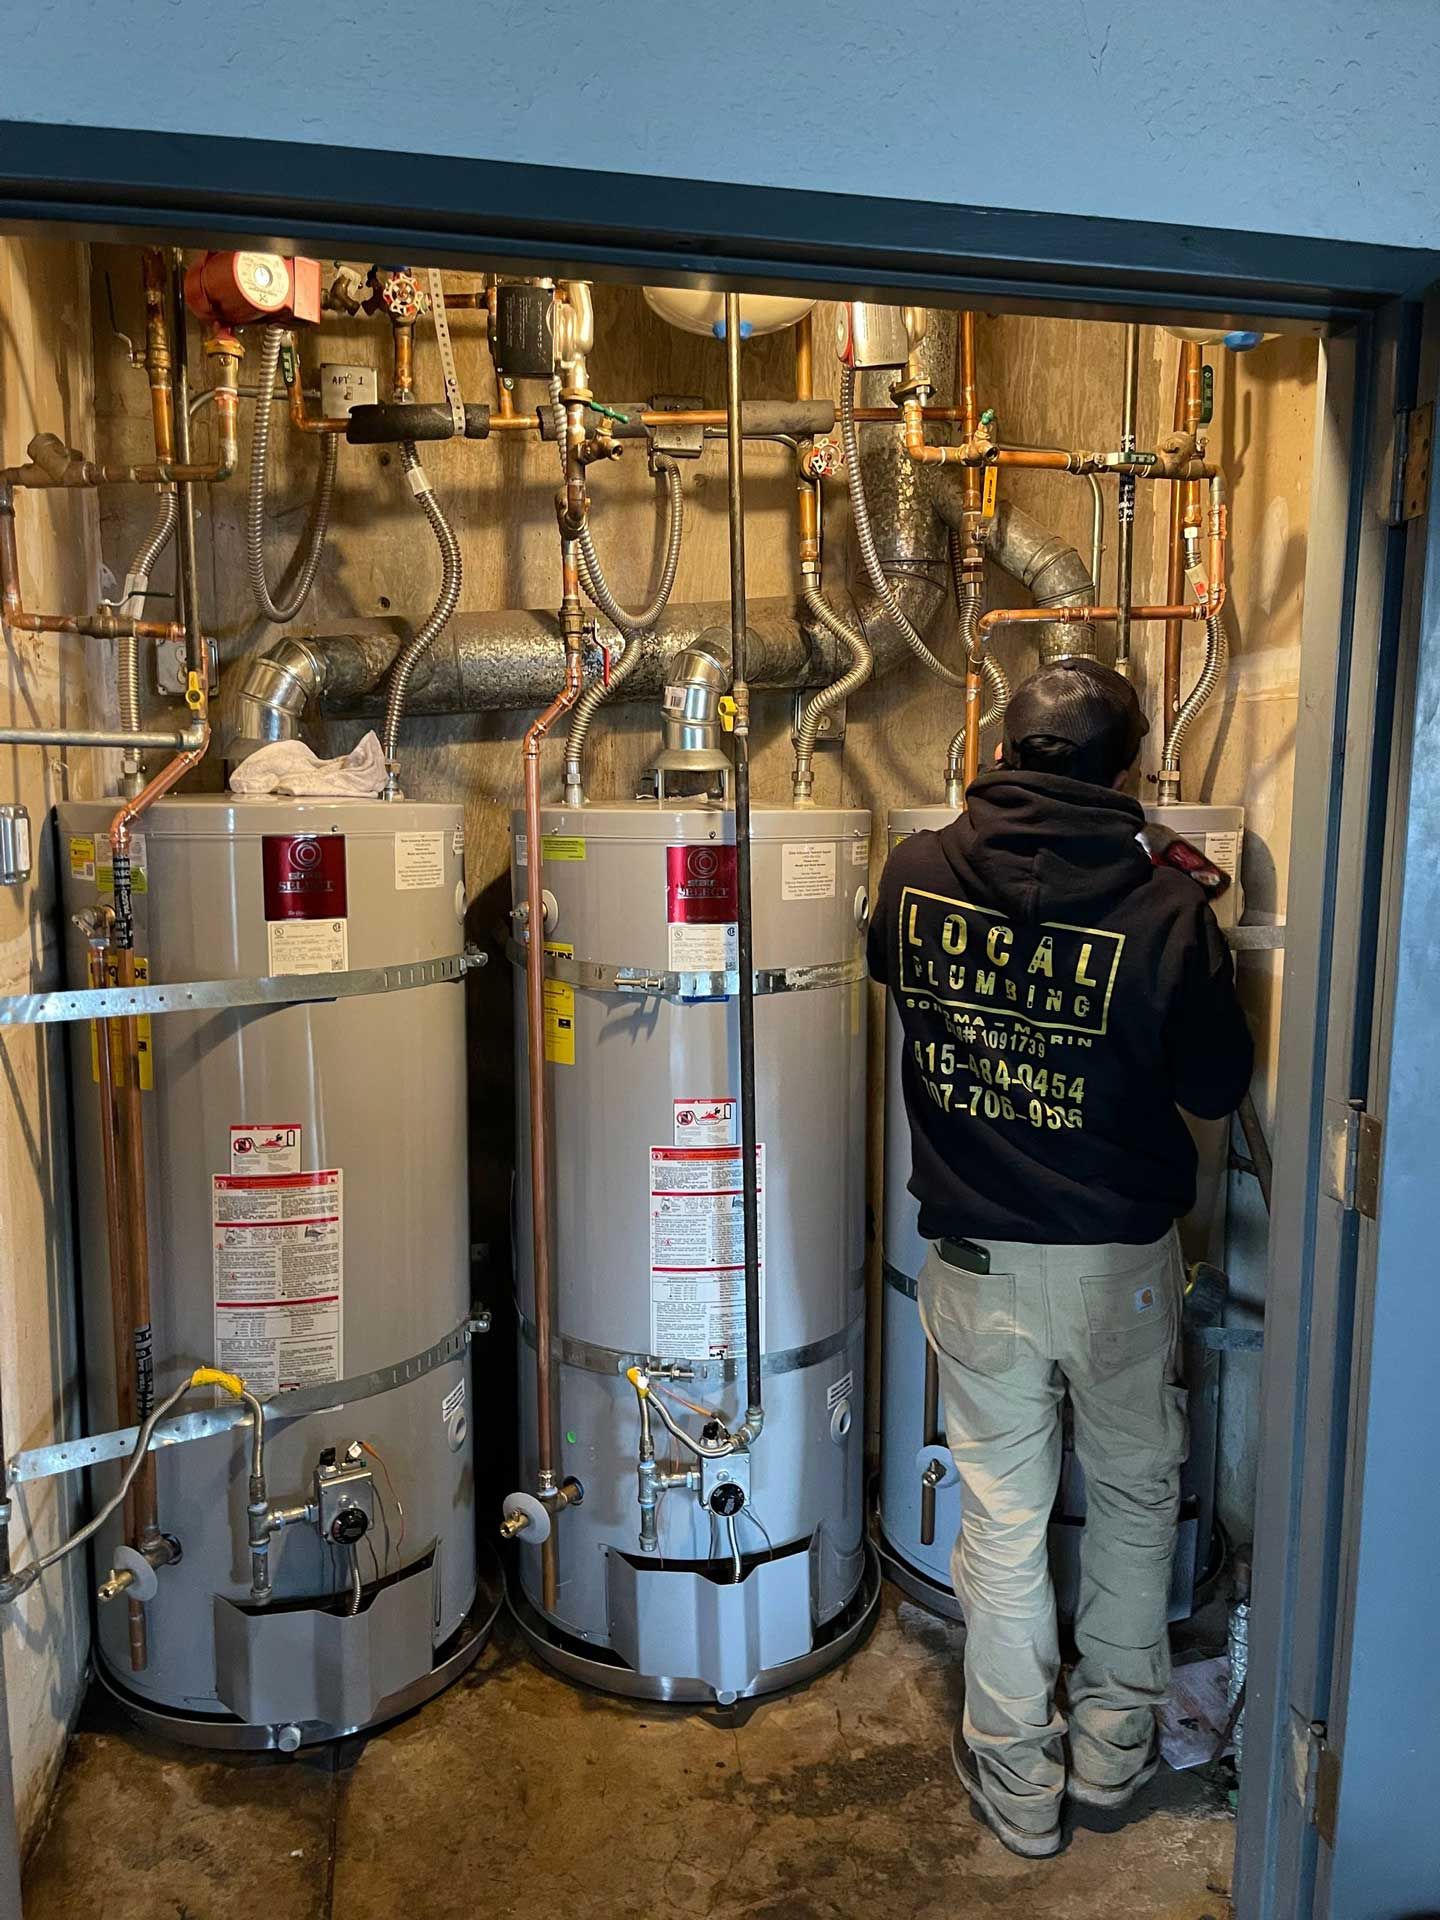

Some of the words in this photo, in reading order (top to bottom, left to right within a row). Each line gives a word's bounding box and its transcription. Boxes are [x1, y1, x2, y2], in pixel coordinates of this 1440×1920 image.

[332, 375, 348, 385] APT
[358, 375, 364, 386] 1
[278, 880, 334, 891] SELT
[908, 903, 1097, 988] LOCAL
[912, 955, 1091, 1018] PLUMBING
[981, 1029, 1045, 1058] 1091739
[1014, 1022, 1092, 1048] MARIN
[914, 1040, 1085, 1104] 415-484-0454
